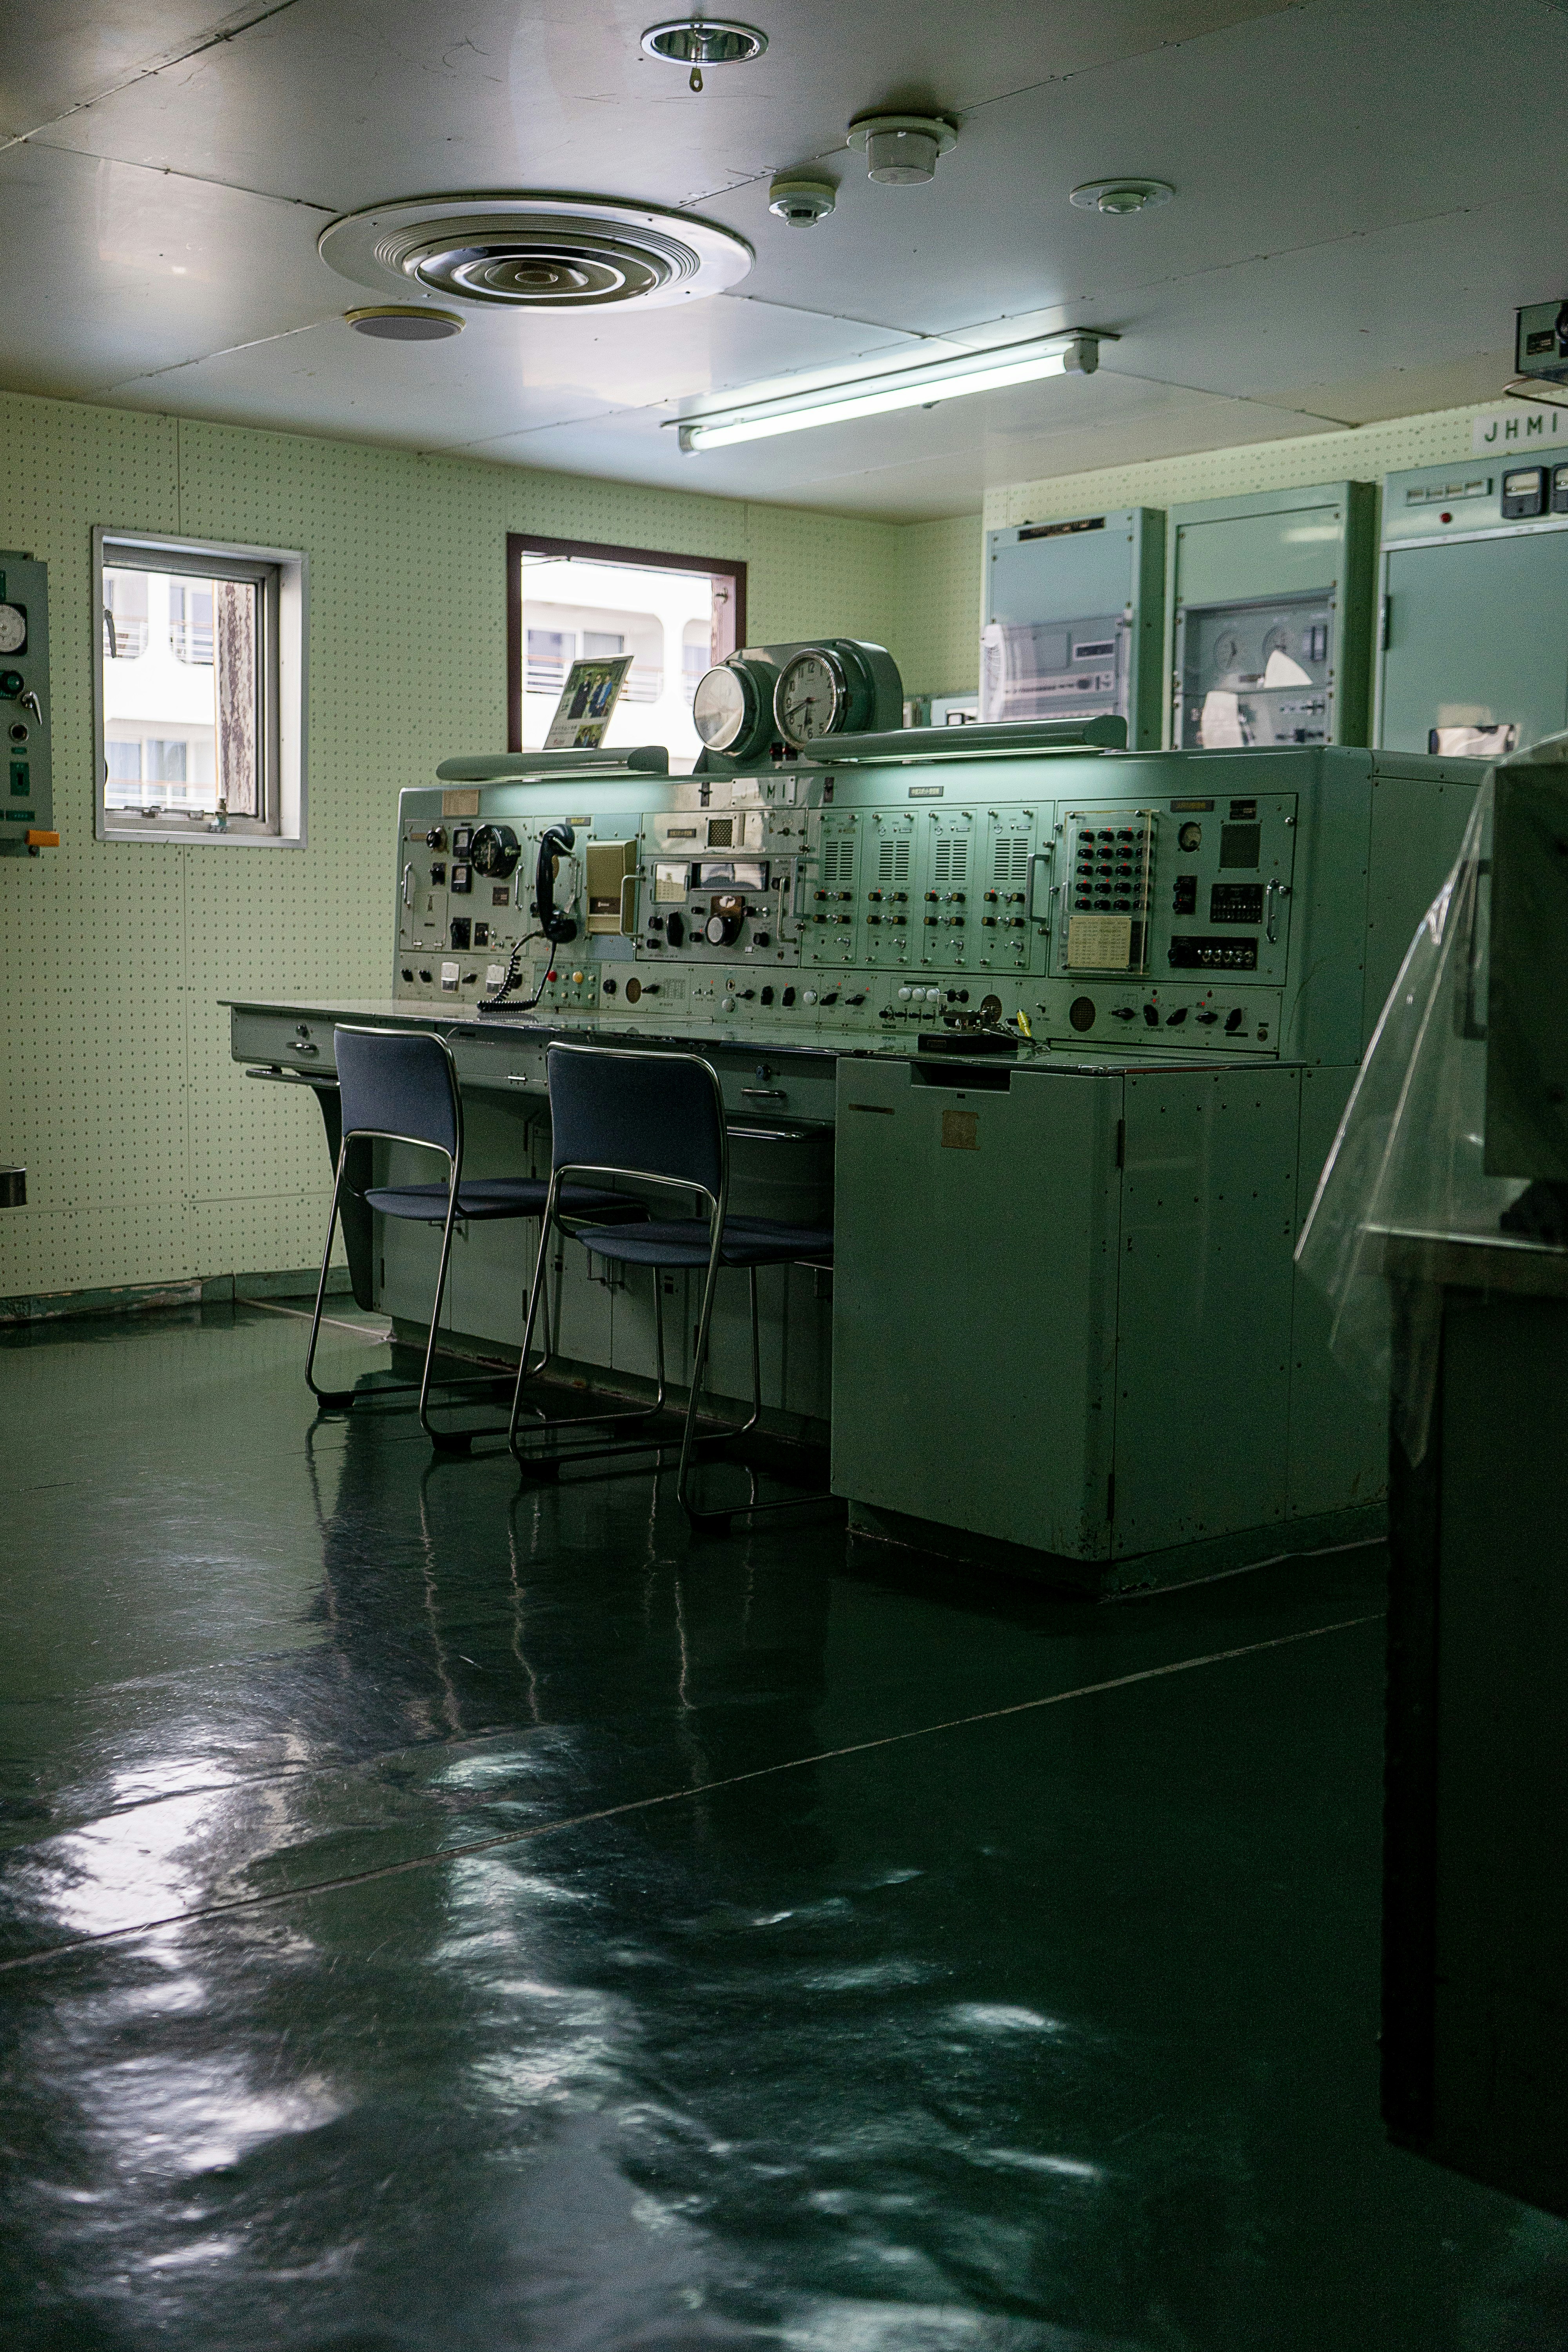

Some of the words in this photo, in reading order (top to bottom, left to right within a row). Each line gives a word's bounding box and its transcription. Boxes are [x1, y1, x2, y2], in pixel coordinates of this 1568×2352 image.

[1484, 411, 1558, 442] JHMI
[798, 667, 804, 678] 11
[808, 661, 815, 673] 12
[786, 697, 791, 708] 9
[797, 724, 802, 736] 7
[808, 728, 813, 739] 6
